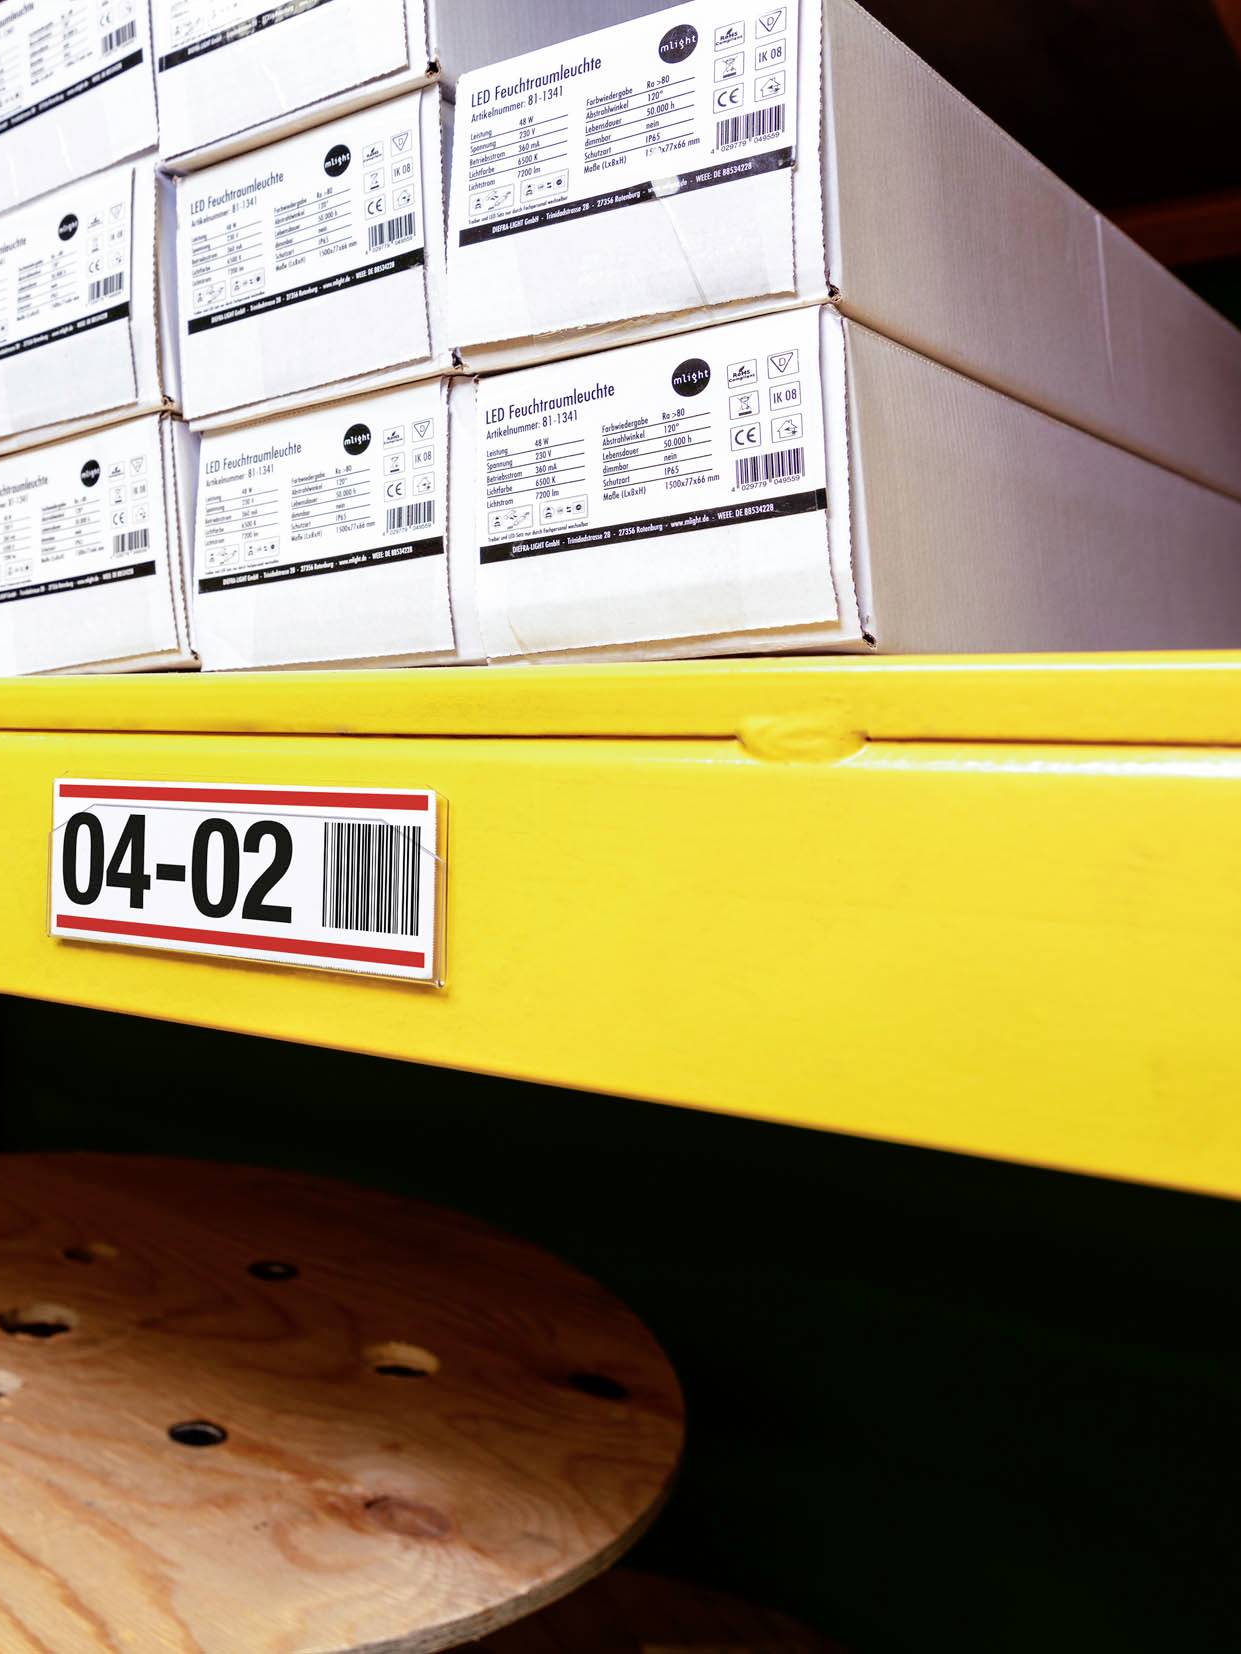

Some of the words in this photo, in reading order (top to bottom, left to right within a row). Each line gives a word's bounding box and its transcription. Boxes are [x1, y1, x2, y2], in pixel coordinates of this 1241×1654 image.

[660, 35, 696, 53] mlight
[758, 51, 767, 63] IK
[770, 46, 782, 60] 08
[471, 89, 491, 108] LED
[495, 57, 602, 100] Feuchtraumleuchte
[586, 87, 633, 107] Farbwiedergabe
[656, 75, 670, 86] >80
[471, 101, 526, 123] Artikelnummer:
[528, 85, 563, 106] 81-1341
[586, 100, 629, 120] Abstrahlwinkel
[647, 90, 664, 102] 120°
[717, 87, 739, 107] CE
[585, 118, 622, 133] Lebensdauer
[646, 103, 669, 116] 50.000
[670, 101, 675, 109] h
[470, 130, 492, 140] Leistung
[519, 118, 526, 126] 48
[584, 134, 611, 147] dimmbar
[645, 120, 660, 129] nein
[470, 141, 497, 153] Spannung
[519, 130, 530, 139] 230
[584, 147, 612, 160] Schutzart
[645, 133, 661, 143] IP65
[721, 141, 747, 152] 029779
[469, 151, 506, 166] Betriebsstrom
[518, 142, 529, 152] 360
[602, 156, 627, 170] (LxBxH)
[688, 138, 701, 147] mm
[393, 166, 400, 177] IK
[402, 163, 411, 174] 08
[469, 167, 495, 178] Lichtfarbe
[517, 155, 533, 165] 6500
[468, 180, 496, 191] Lichtstrom
[517, 168, 532, 178] 7200
[582, 203, 590, 211] 28
[597, 197, 614, 208] 27356
[714, 170, 722, 178] DE
[191, 199, 205, 215] LED
[208, 171, 284, 208] Feuchtraumleuchte
[673, 368, 709, 385] mlight
[486, 407, 505, 424] LED
[509, 383, 615, 420] Feuchtraumleuchte
[773, 393, 782, 404] IK
[785, 388, 797, 401] 08
[486, 422, 540, 440] Artikelnummer:
[542, 409, 578, 428] 81-1341
[601, 416, 649, 433] Farbwiedergabe
[672, 407, 685, 418] >80
[344, 433, 370, 446] mlight
[602, 429, 645, 446] Abstrahlwinkel
[663, 423, 679, 434] 120°
[734, 427, 757, 445] CE
[206, 460, 220, 474] LED
[223, 441, 302, 470] Feuchtraumleuchte
[414, 454, 422, 463] IK
[423, 451, 432, 461] 08
[486, 448, 508, 458] Leistung
[534, 438, 542, 447] 48
[602, 448, 639, 461] Lebensdauer
[663, 436, 686, 448] 50.000
[687, 434, 692, 443] h
[486, 459, 513, 470] Spannung
[535, 451, 546, 460] 230
[602, 463, 629, 474] dimmbar
[663, 453, 677, 461] nein
[486, 471, 523, 484] Betriebsstrom
[535, 465, 546, 474] 360
[548, 463, 557, 471] mA
[602, 476, 630, 487] Schutzart
[664, 465, 680, 476] IP65
[741, 480, 767, 491] 029779
[774, 475, 800, 485] 049559
[486, 485, 512, 496] Lichtfarbe
[535, 477, 551, 487] 6500
[552, 475, 556, 483] K
[621, 486, 646, 499] (LxBxH)
[665, 475, 705, 490] 1500x77x66
[707, 473, 720, 483] mm
[486, 498, 513, 509] Lichtstrom
[535, 490, 551, 499] 7200
[551, 488, 559, 497] lm
[545, 539, 560, 548] GmbH
[603, 531, 611, 539] 28
[618, 527, 636, 537] 27356
[636, 522, 663, 534] Rotenburg
[670, 515, 710, 528] www.mlight.de
[717, 511, 734, 520] WEEE:
[735, 508, 744, 517] DE
[744, 503, 774, 516] 88534228
[62, 811, 294, 924] 04-02
